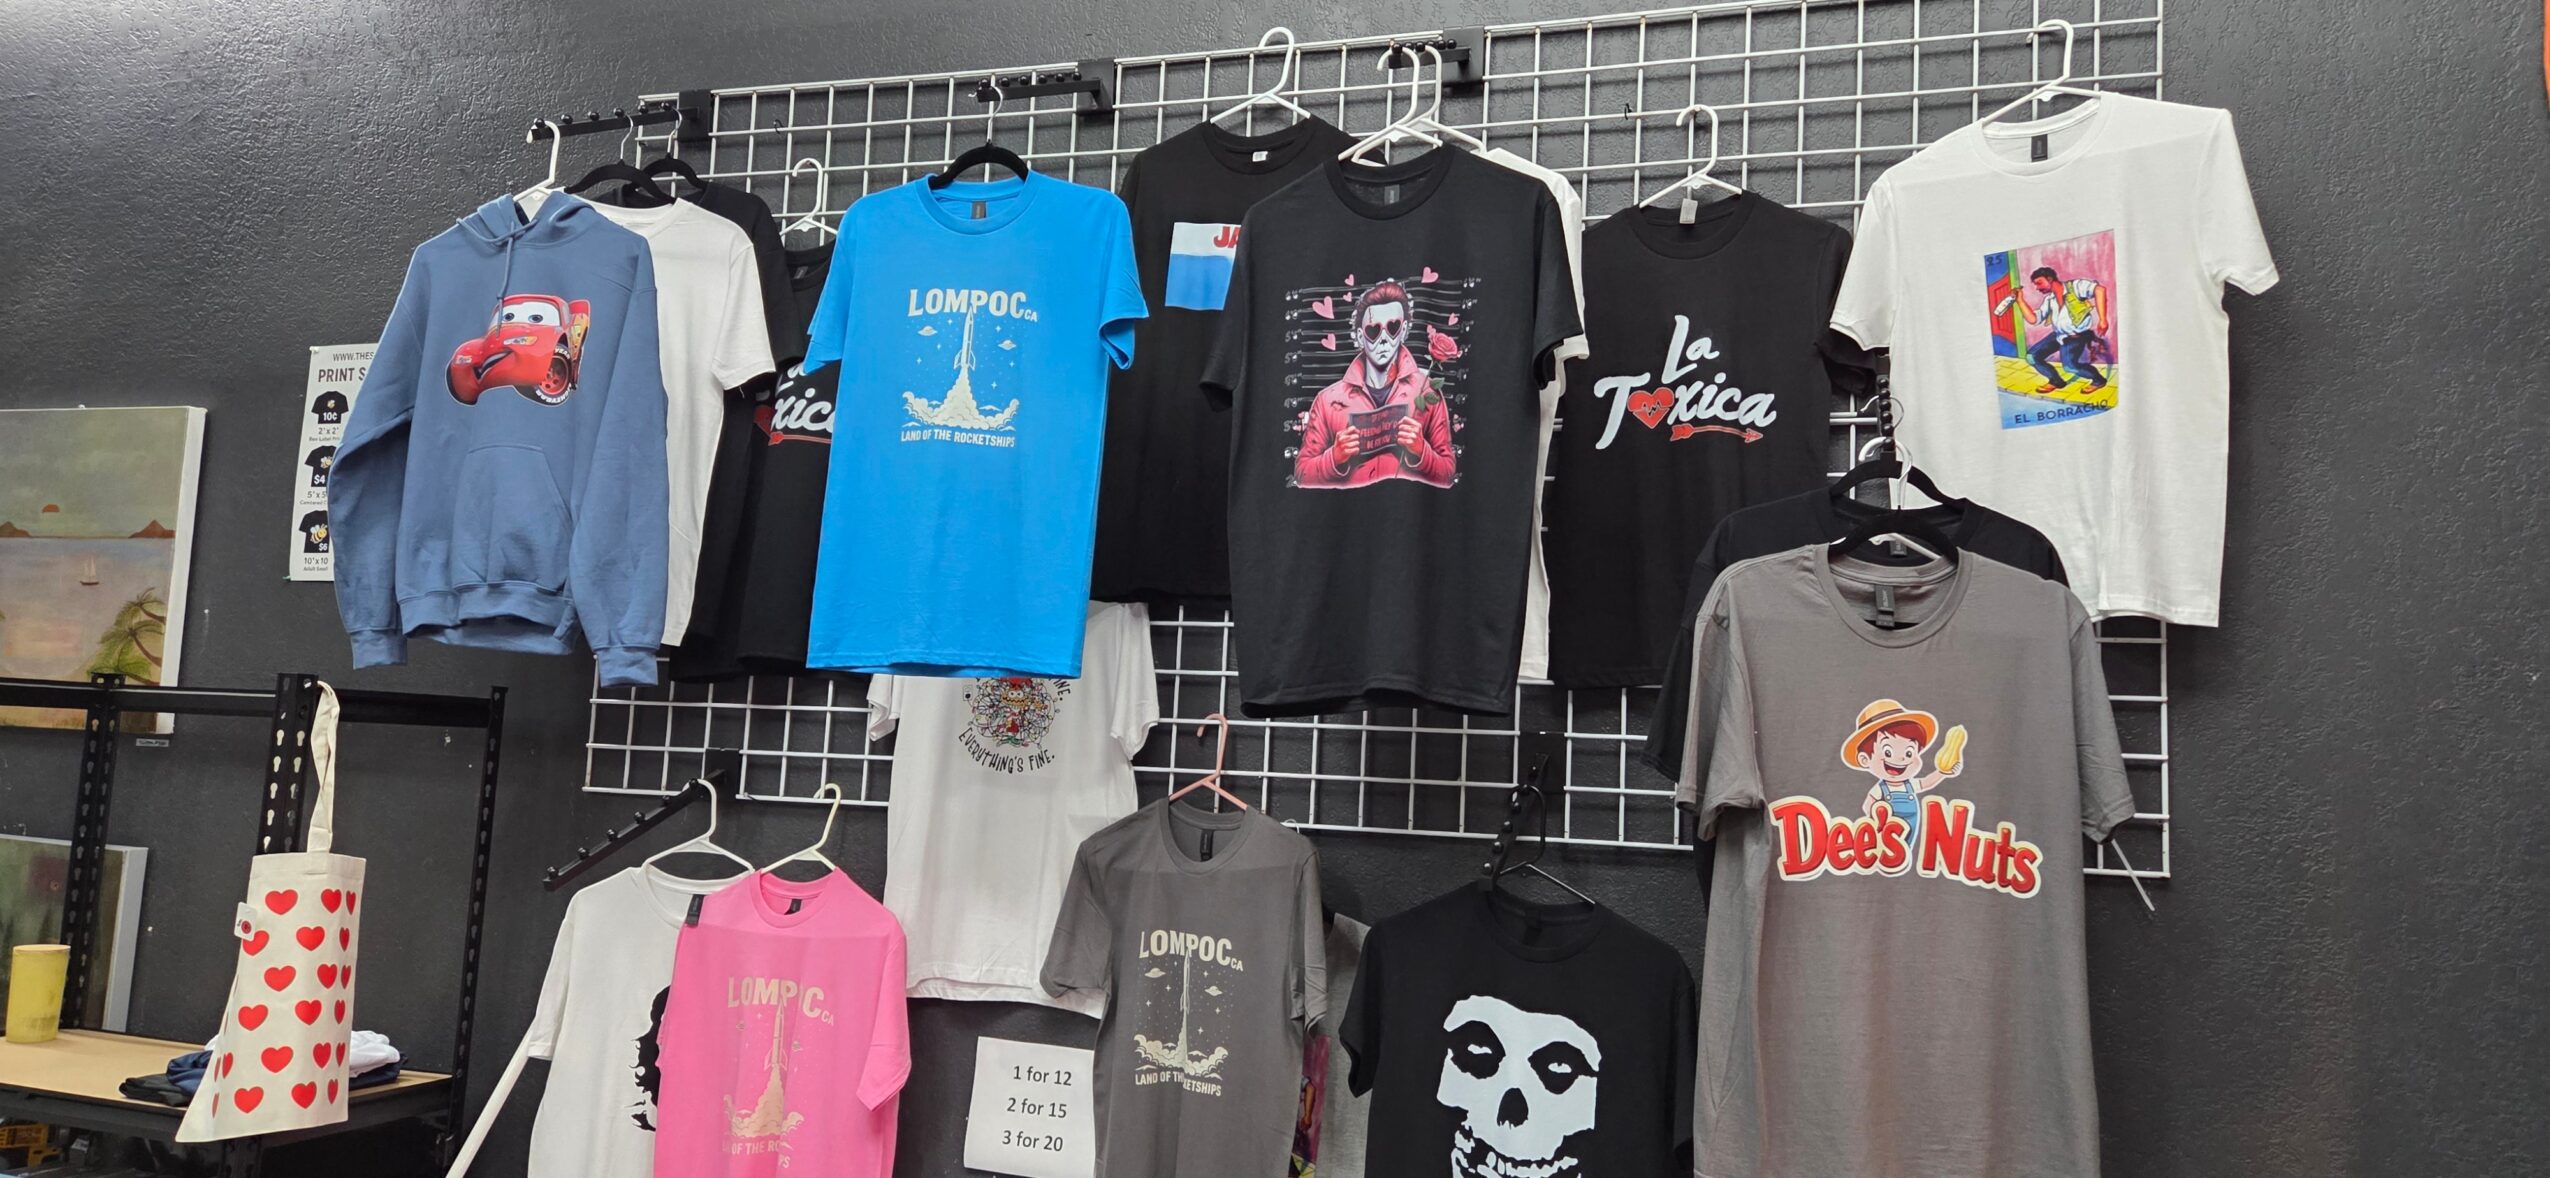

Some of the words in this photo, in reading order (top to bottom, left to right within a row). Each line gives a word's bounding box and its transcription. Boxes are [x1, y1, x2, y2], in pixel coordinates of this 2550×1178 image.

[908, 288, 1027, 318] LOMPOC
[1024, 309, 1038, 322] CA
[1661, 314, 1720, 384] La
[318, 368, 355, 382] PRINT
[2014, 414, 2031, 424] EL
[2037, 399, 2109, 421] BORRACHO
[901, 430, 921, 441] LAND
[922, 429, 932, 440] OF
[933, 429, 951, 440] THE
[953, 432, 1015, 447] ROCKETSHIPS
[313, 474, 325, 485] $4
[958, 727, 1023, 773] EVERYTHING'S
[1029, 749, 1055, 771] FINE.
[1772, 801, 1906, 876] Dee's
[1921, 801, 2038, 894] Nuts
[1139, 929, 1232, 966] LOMPOC
[1230, 957, 1244, 971] CA
[727, 976, 824, 1018] LOMPC
[821, 1010, 834, 1026] CA
[1013, 1065, 1021, 1080] 1
[1027, 1066, 1049, 1083] for
[1054, 1070, 1072, 1086] 12
[1135, 1073, 1158, 1085] LAND
[1160, 1071, 1171, 1082] OF
[1007, 1097, 1016, 1112] 2
[1021, 1098, 1044, 1115] for
[1048, 1102, 1067, 1118] 15
[731, 1143, 743, 1155] OF
[745, 1141, 765, 1155] THE
[1002, 1130, 1012, 1145] 3
[1016, 1131, 1039, 1148] for
[1043, 1135, 1063, 1152] 20
